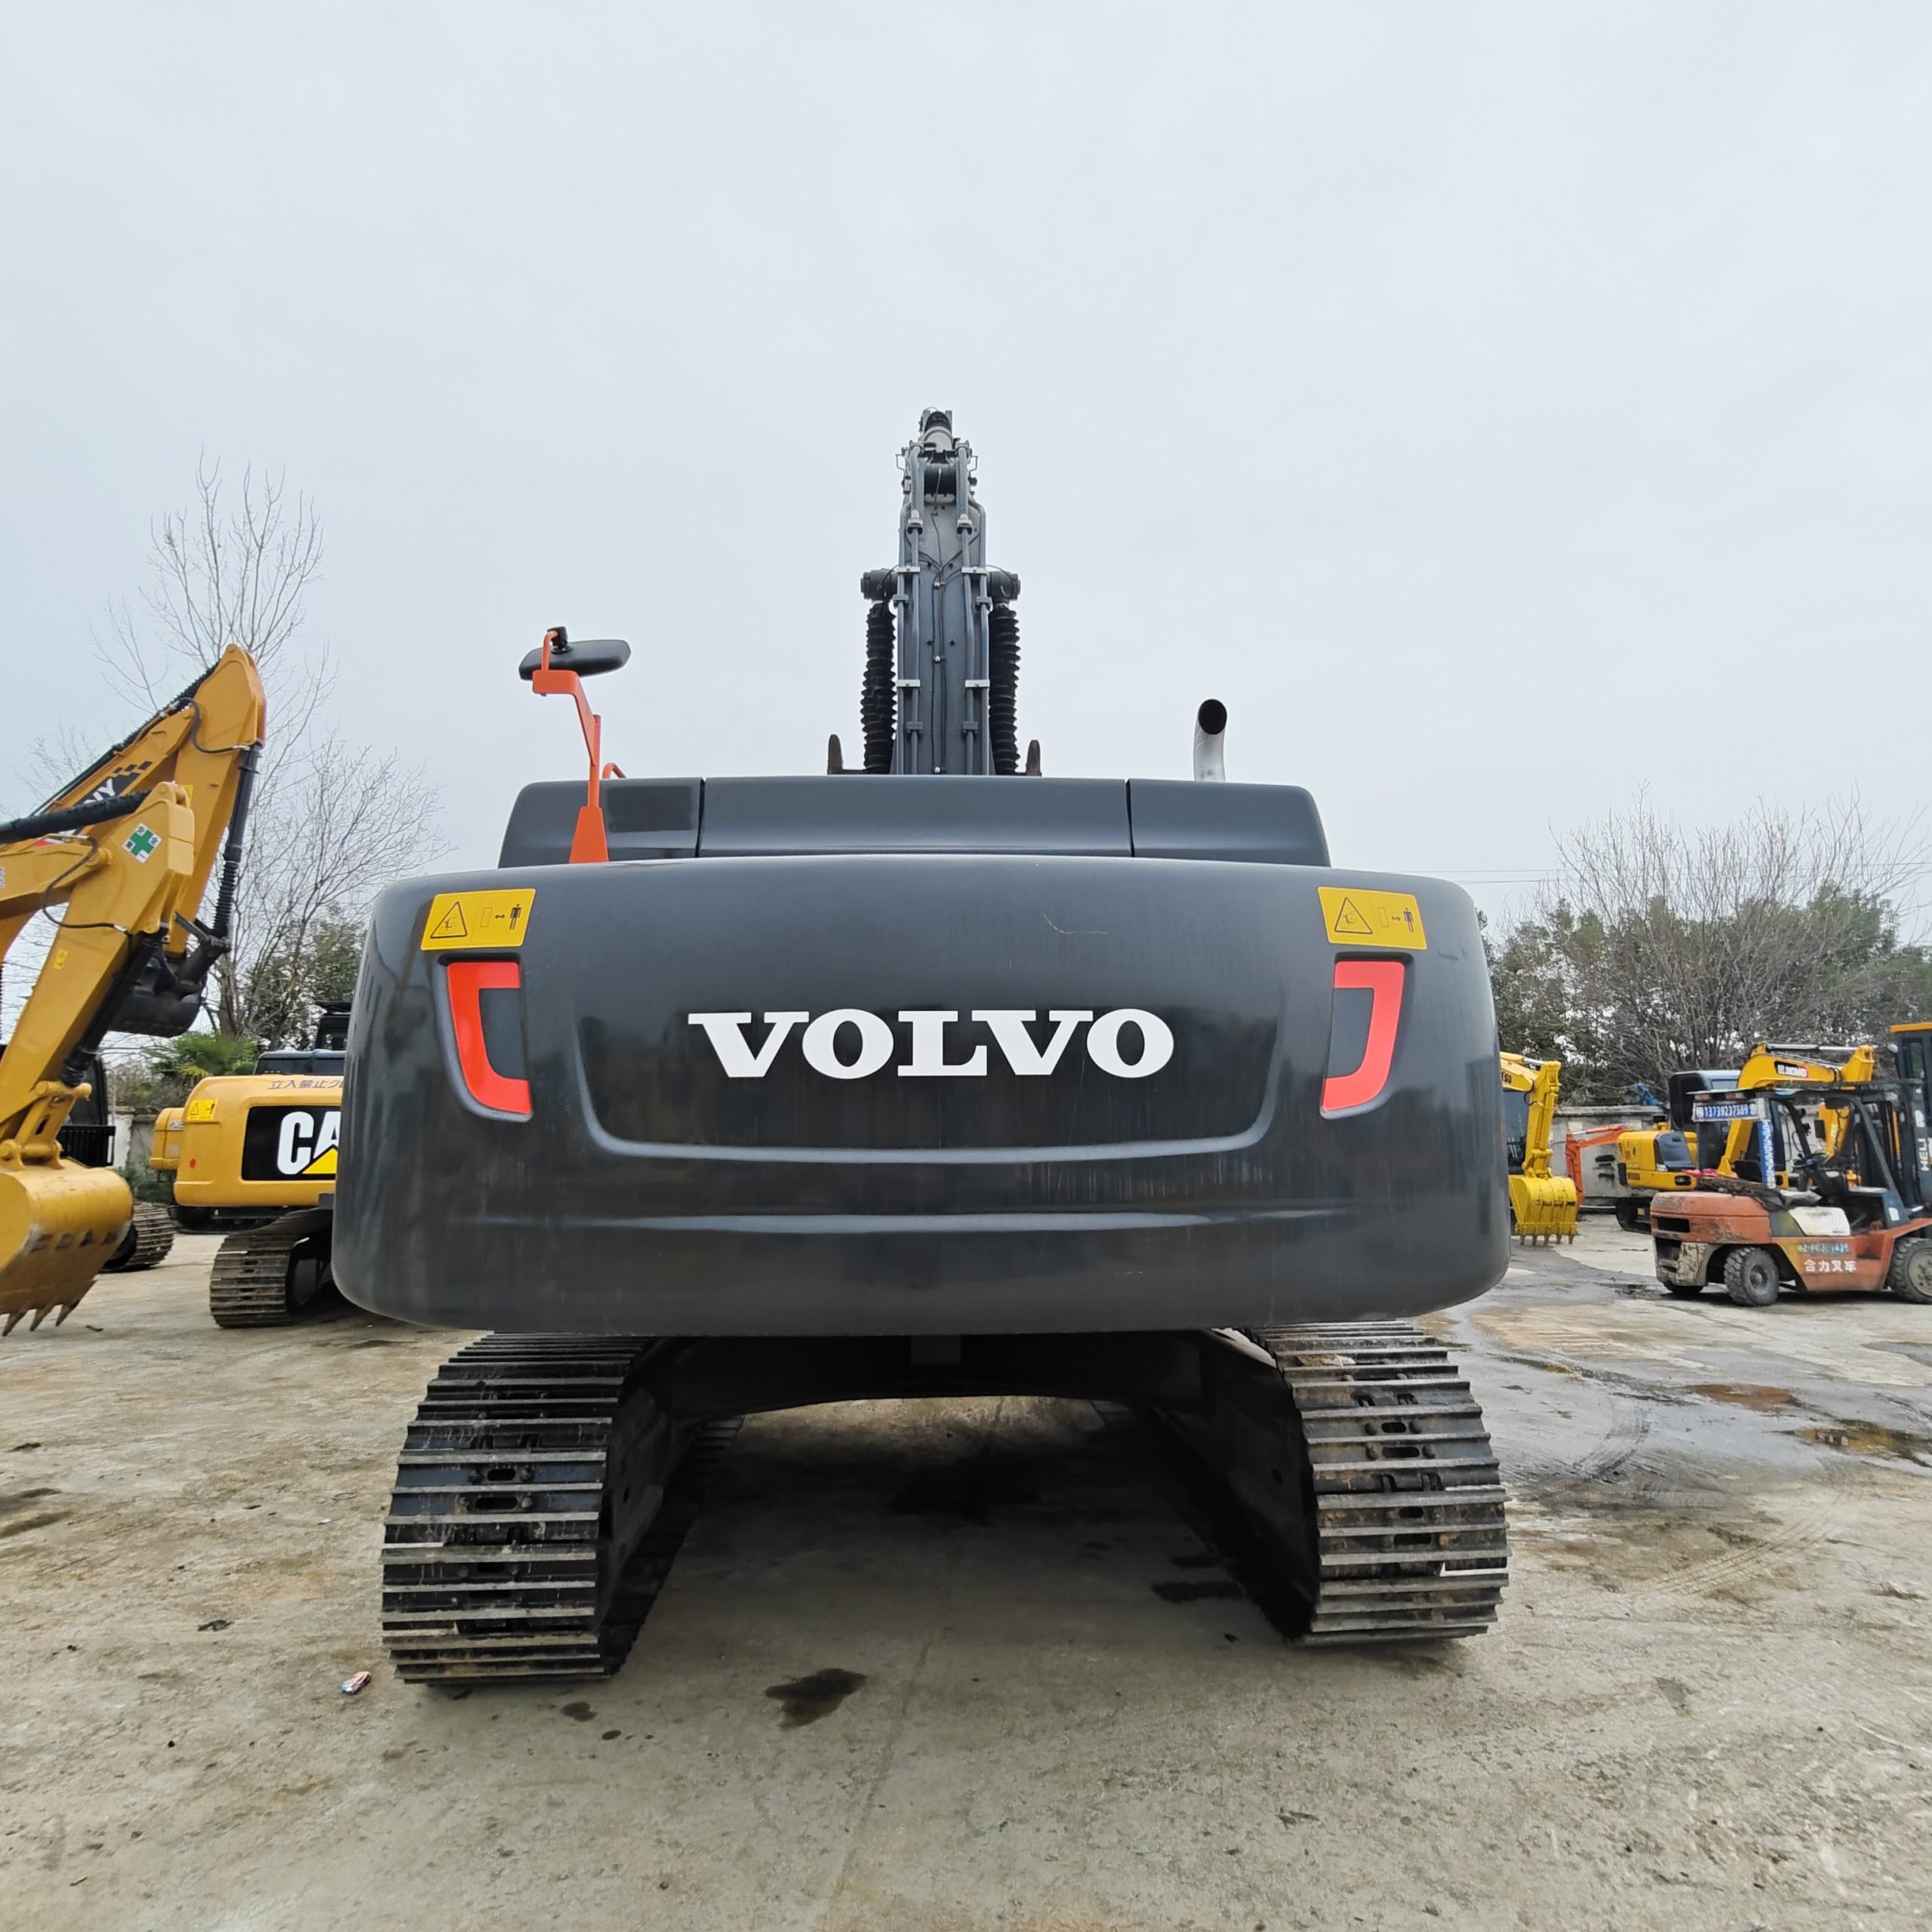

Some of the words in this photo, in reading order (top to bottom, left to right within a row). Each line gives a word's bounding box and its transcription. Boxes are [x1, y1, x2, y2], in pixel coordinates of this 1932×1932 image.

[688, 1008, 1174, 1080] VOLVO
[277, 1111, 342, 1175] CA
[1918, 1137, 1930, 1171] HELI
